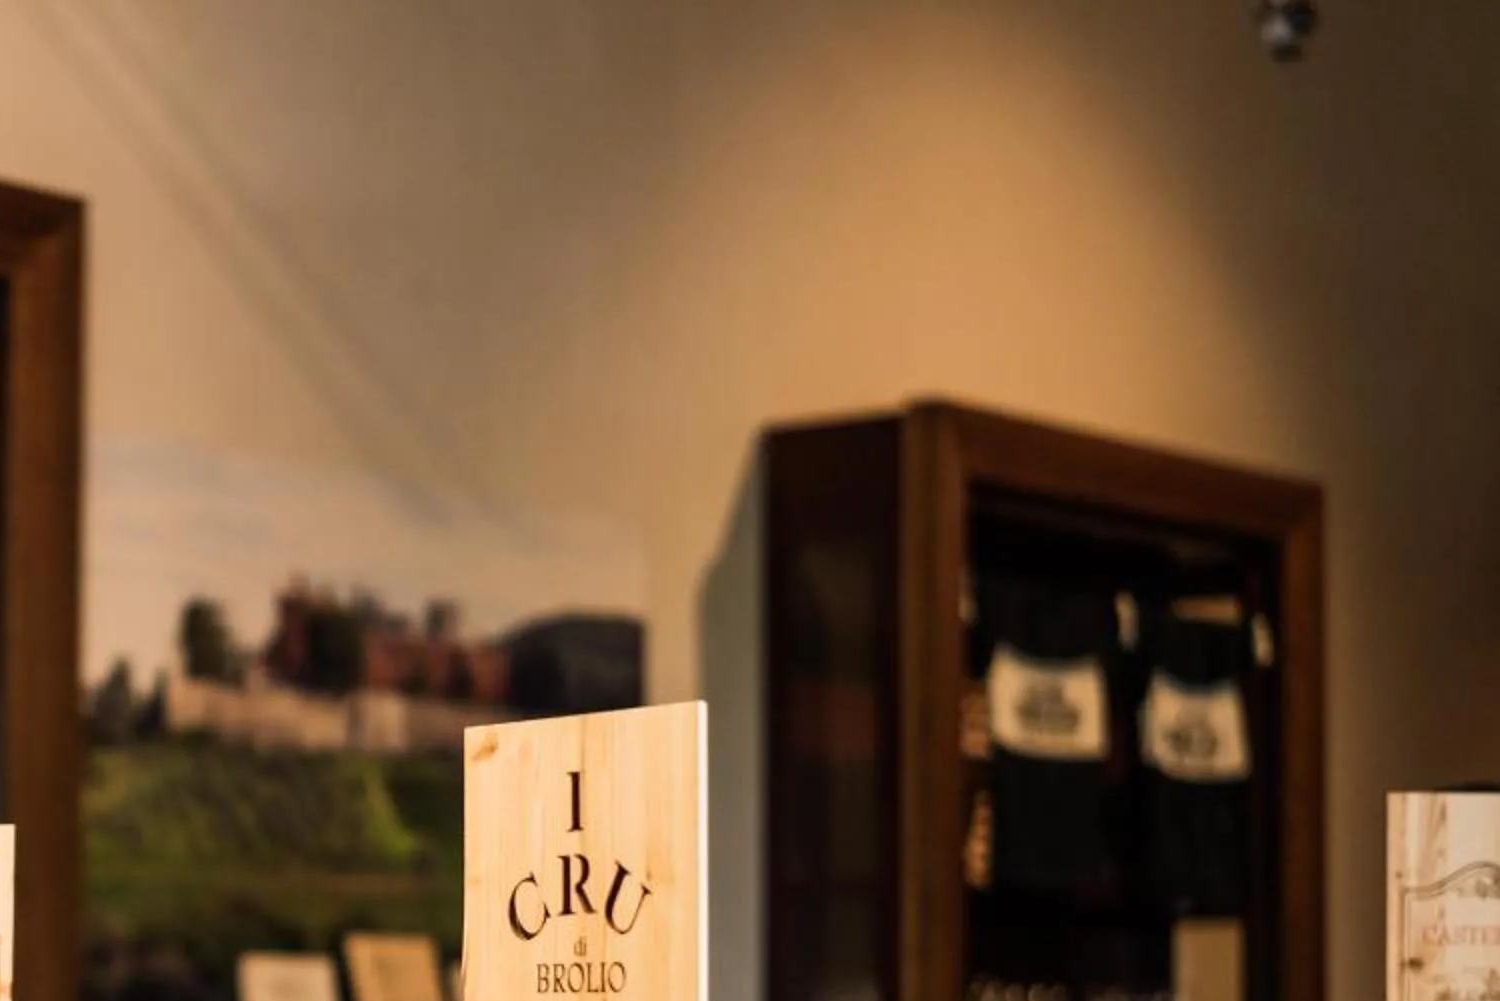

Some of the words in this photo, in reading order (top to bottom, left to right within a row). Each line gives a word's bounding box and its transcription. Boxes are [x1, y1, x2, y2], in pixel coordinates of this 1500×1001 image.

[566, 771, 584, 833] I
[507, 853, 653, 941] CRU
[573, 935, 588, 957] di
[535, 961, 627, 994] BROLIO
